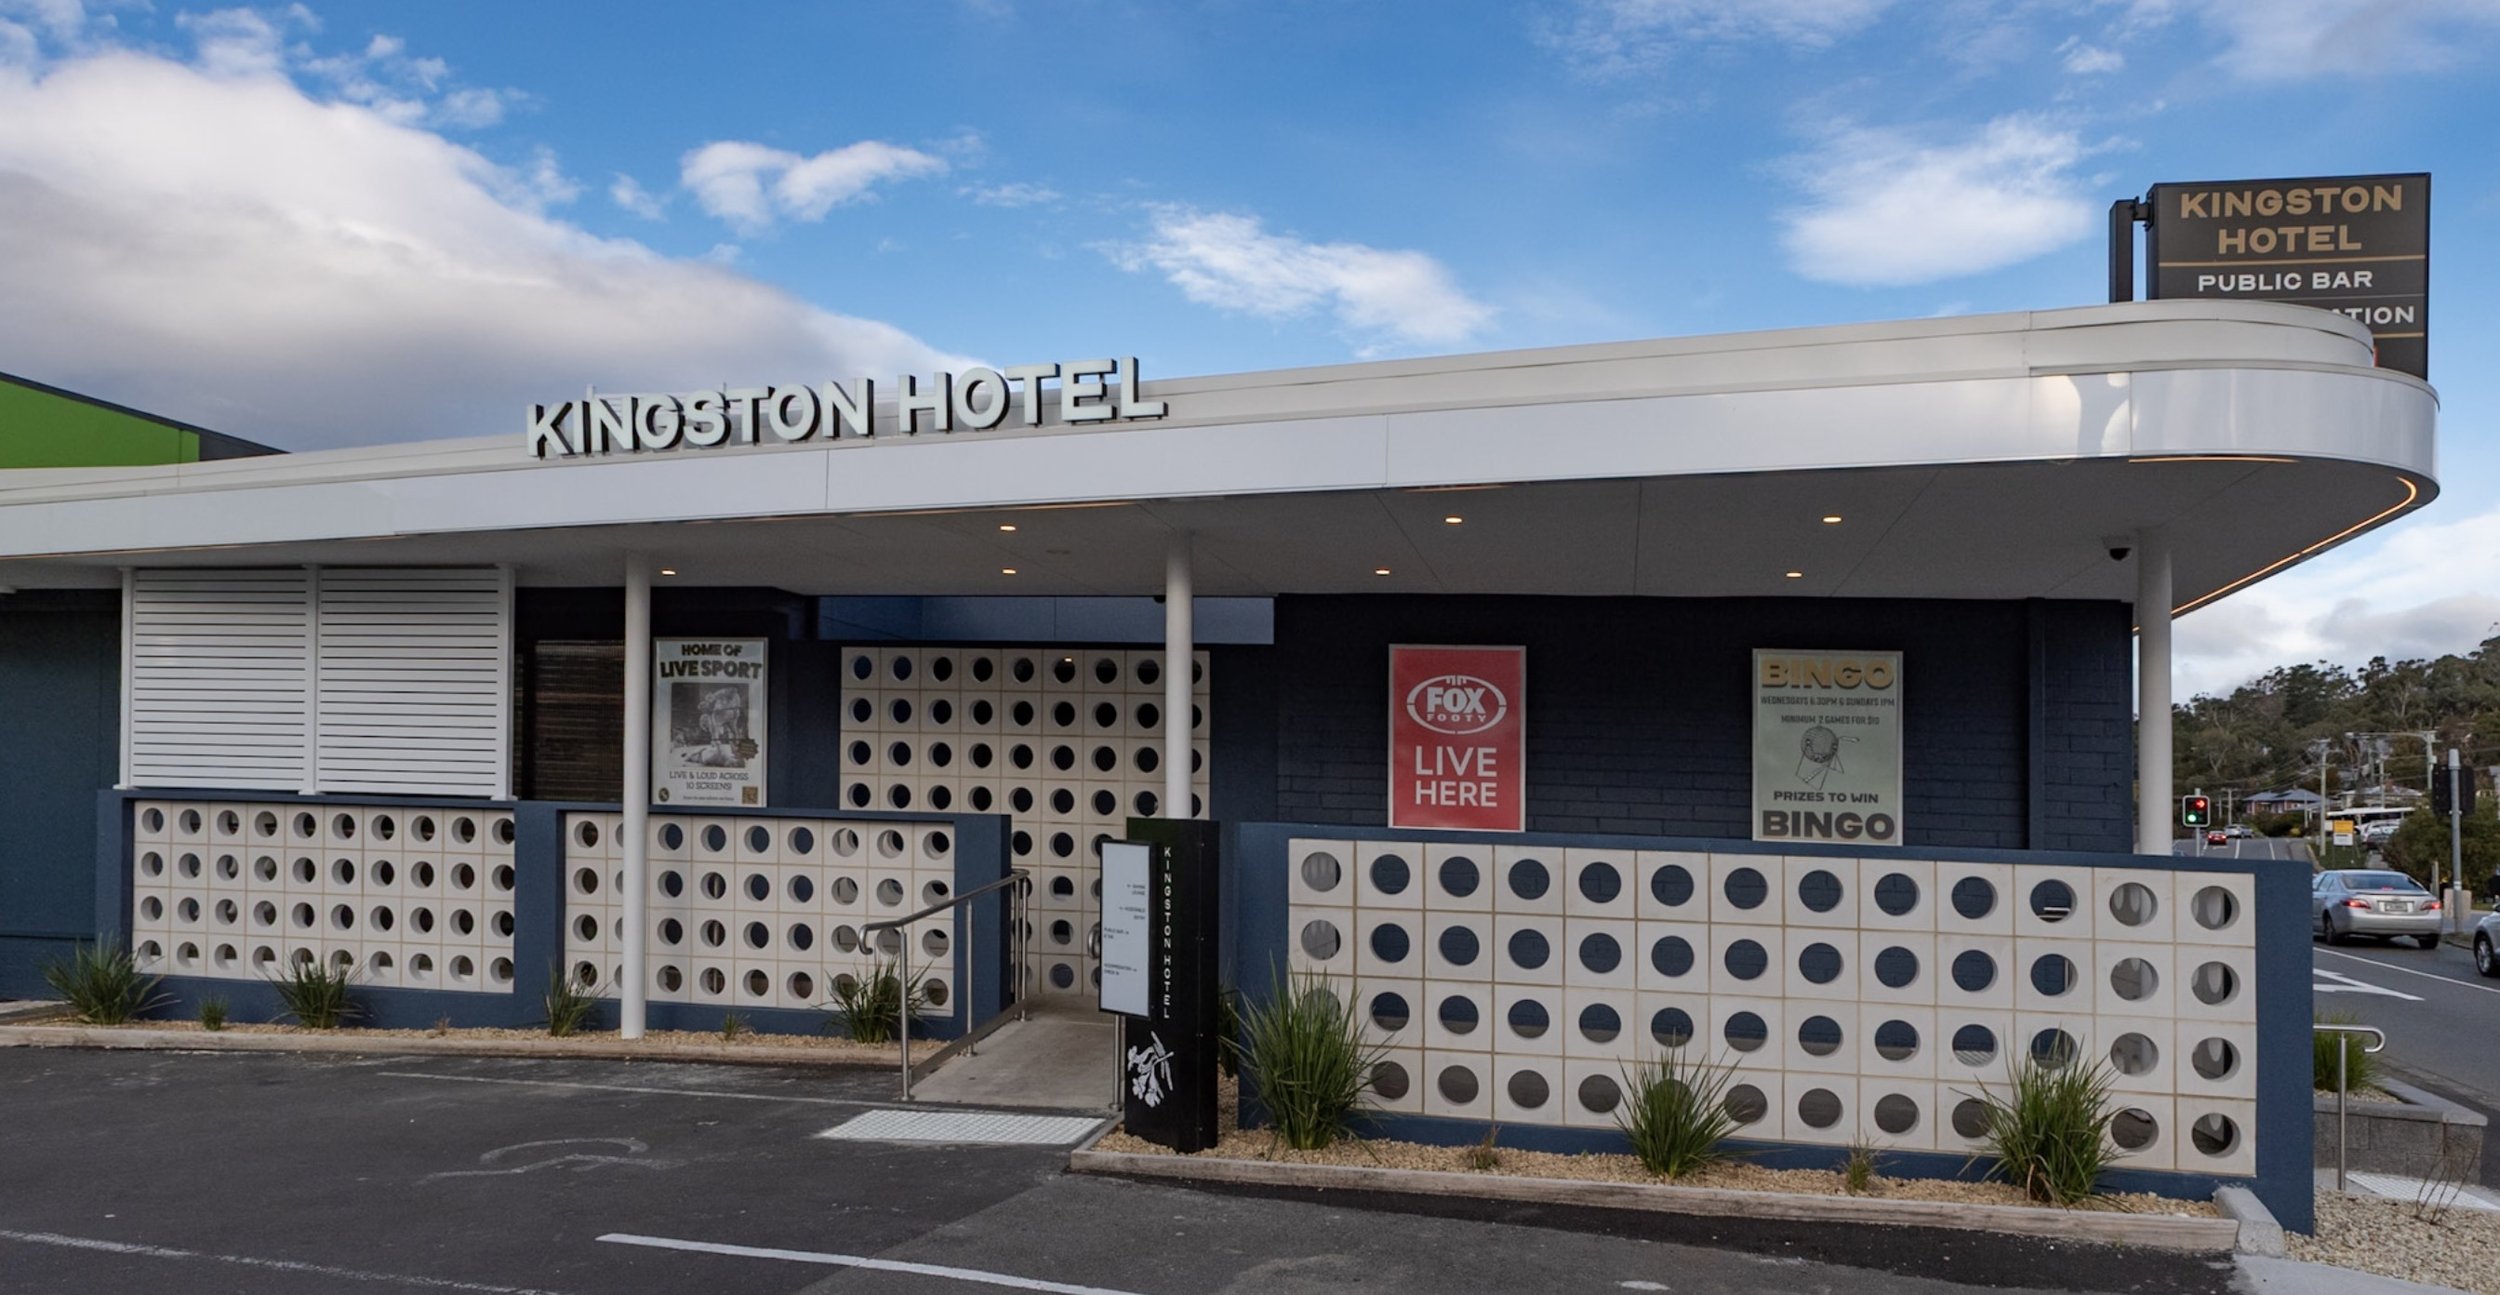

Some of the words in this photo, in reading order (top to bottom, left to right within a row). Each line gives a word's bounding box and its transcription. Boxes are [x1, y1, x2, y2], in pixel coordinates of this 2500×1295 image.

[2180, 184, 2402, 219] KINGSTON
[2217, 224, 2362, 255] HOTEL
[2197, 272, 2302, 292] PUBLIC
[2311, 270, 2373, 289] BAR
[527, 377, 874, 460] KINGSTON
[898, 356, 1169, 435] HOTEL
[681, 644, 722, 656] HOME
[724, 644, 743, 656] OF
[660, 660, 699, 678] LIVE
[701, 660, 762, 679] SPORT
[1761, 657, 1894, 690] BINGO
[1426, 686, 1486, 714] FOX
[1426, 714, 1486, 722] FOOTY
[1825, 716, 1850, 725] GAMES
[1852, 716, 1866, 725] FOR
[1415, 745, 1497, 777] LIVE
[669, 771, 688, 780] LIVE
[696, 772, 718, 780] LOUD
[719, 772, 750, 781] ACROSS
[1415, 780, 1497, 807] HERE
[1773, 790, 1825, 801] PRIZES
[1828, 792, 1847, 802] TO
[1850, 793, 1879, 804] WIN
[1762, 810, 1895, 840] BINGO
[1163, 847, 1172, 949] KINGSTON
[1163, 954, 1172, 1019] HOTEL
